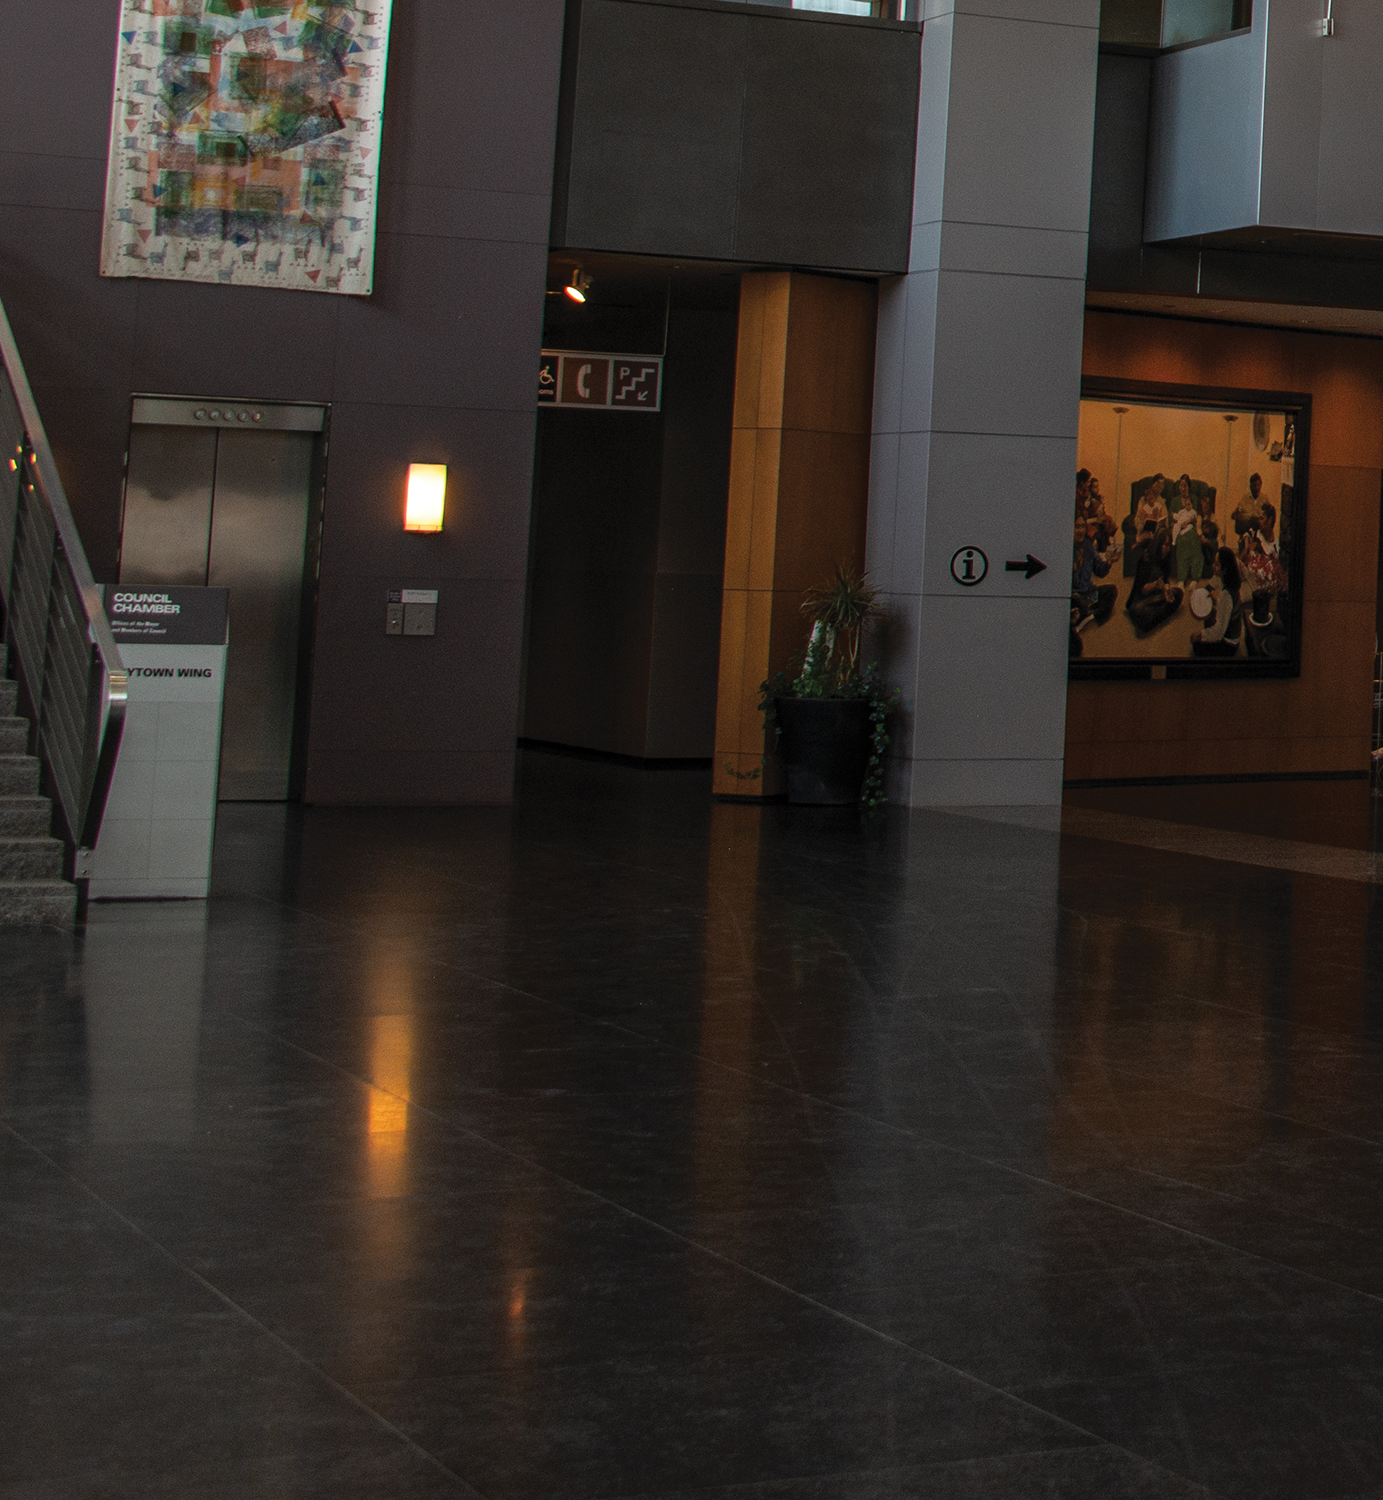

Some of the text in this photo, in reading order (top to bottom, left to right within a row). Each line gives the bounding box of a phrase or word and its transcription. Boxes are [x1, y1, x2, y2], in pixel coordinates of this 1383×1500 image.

[113, 593, 172, 603] COUNCIL
[113, 603, 180, 614] CHAMBER
[127, 668, 212, 678] YTOWN WING
